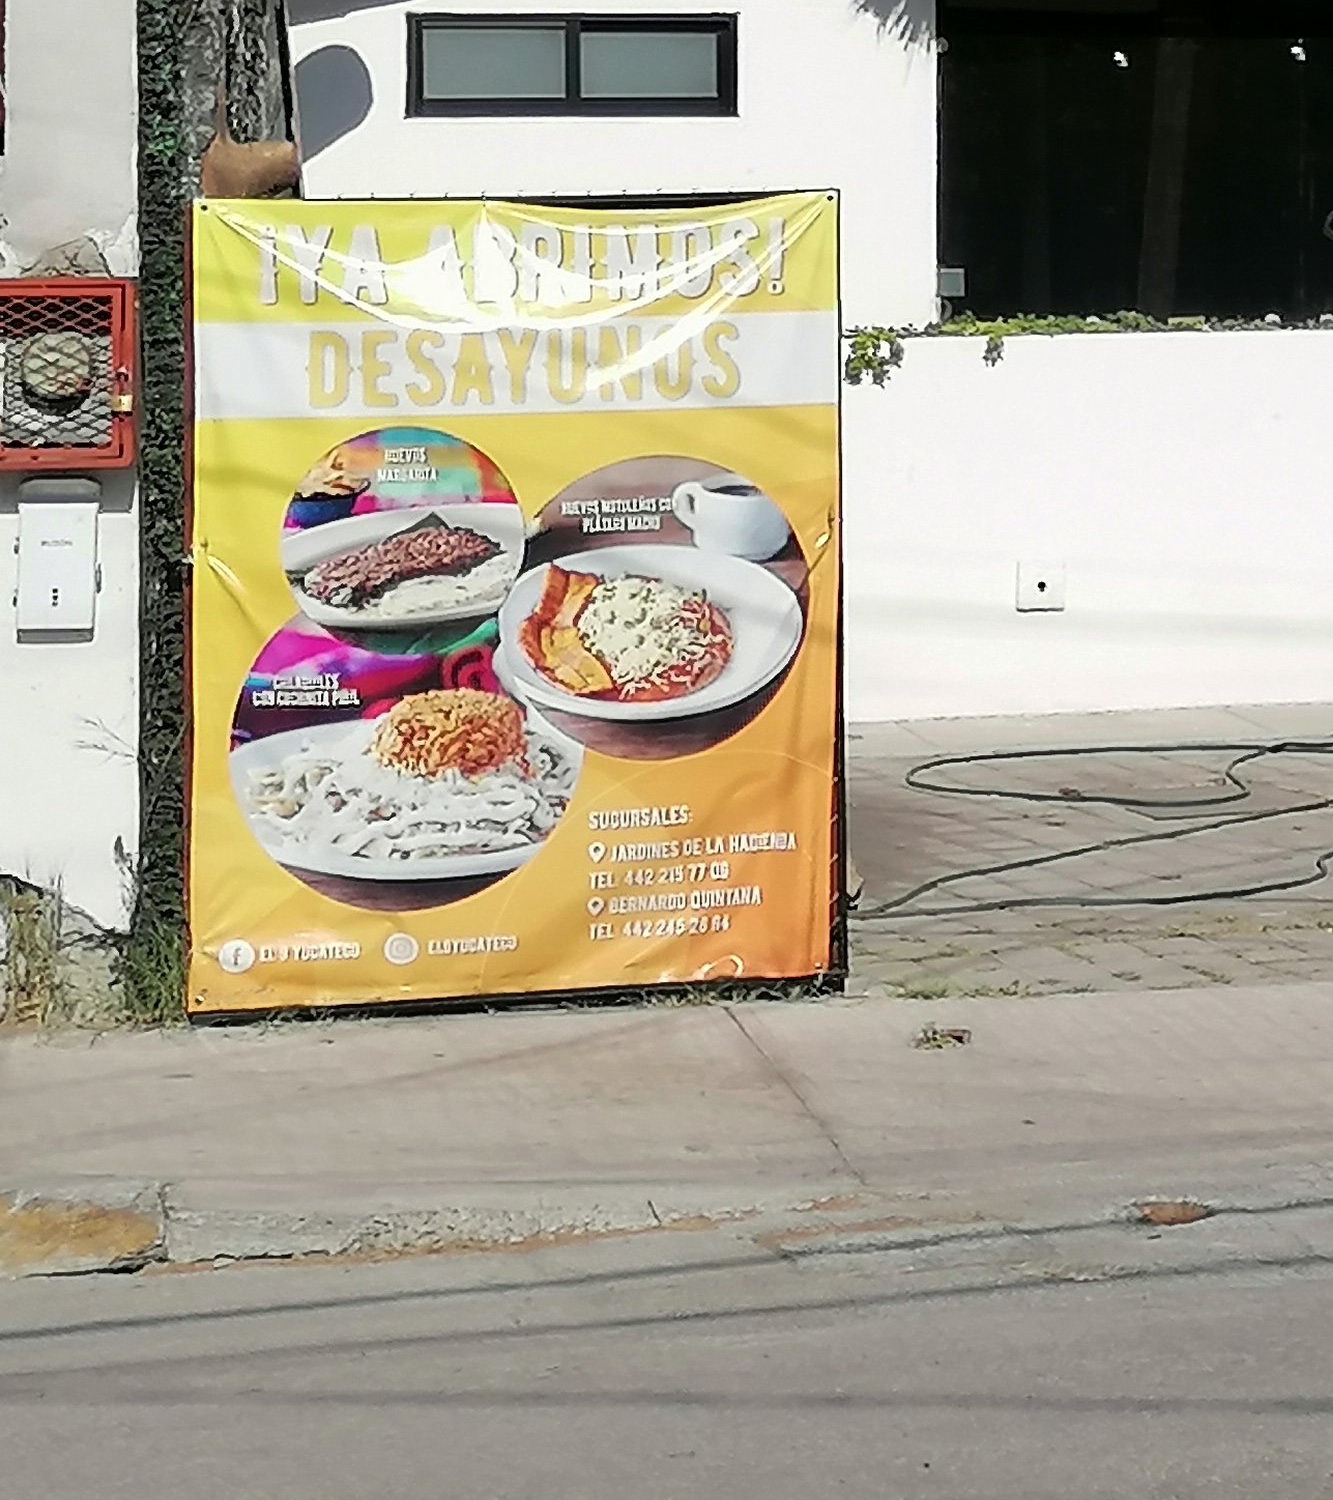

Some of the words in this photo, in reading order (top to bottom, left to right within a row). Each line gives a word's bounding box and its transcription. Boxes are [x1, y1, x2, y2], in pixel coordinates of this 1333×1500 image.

[306, 321, 742, 408] DESAYUNOS
[610, 839, 680, 862] JARDINES
[682, 837, 703, 857] DE
[705, 835, 726, 855] LA
[687, 861, 706, 883] 77
[609, 891, 688, 915] BERNARDO
[690, 885, 763, 911] QUINTANA
